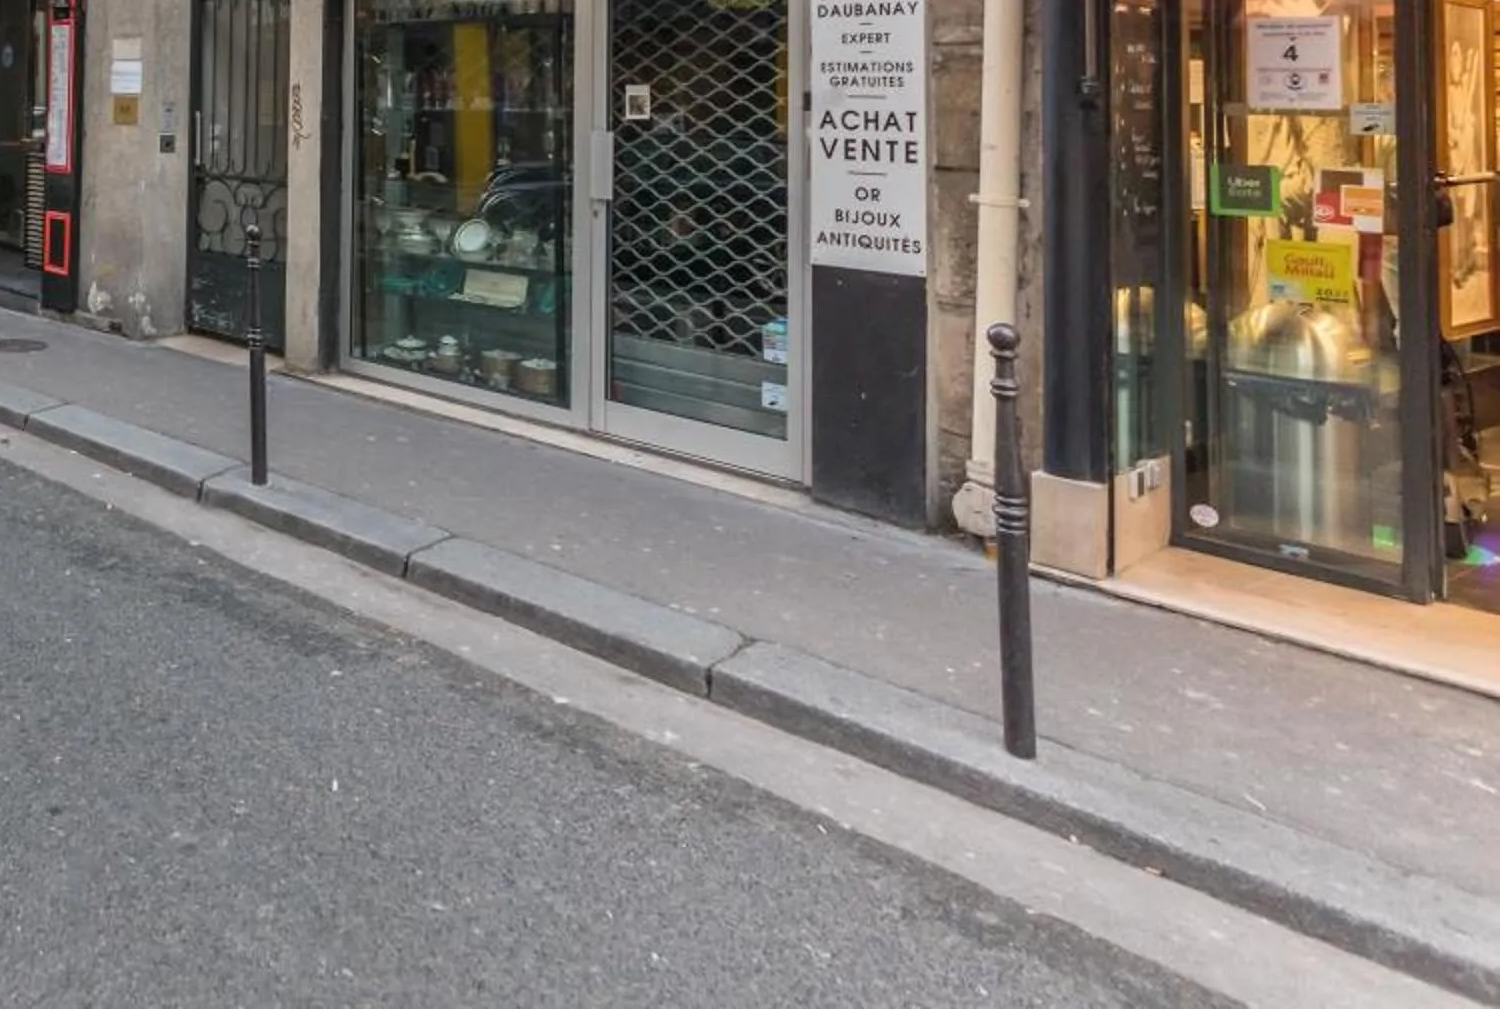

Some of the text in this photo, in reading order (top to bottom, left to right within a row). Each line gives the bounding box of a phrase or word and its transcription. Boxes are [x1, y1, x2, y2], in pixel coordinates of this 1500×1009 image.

[817, 1, 919, 18] DAUBANAY
[842, 32, 891, 44] EXPERT
[1283, 45, 1299, 61] 4
[820, 61, 914, 74] ESTIMATIONS
[829, 75, 905, 88] GRATUITES
[819, 110, 917, 133] ACHAT
[819, 137, 919, 164] VENTE
[1227, 176, 1261, 188] Uber
[854, 187, 881, 202] OR
[835, 208, 900, 228] BIJOUX
